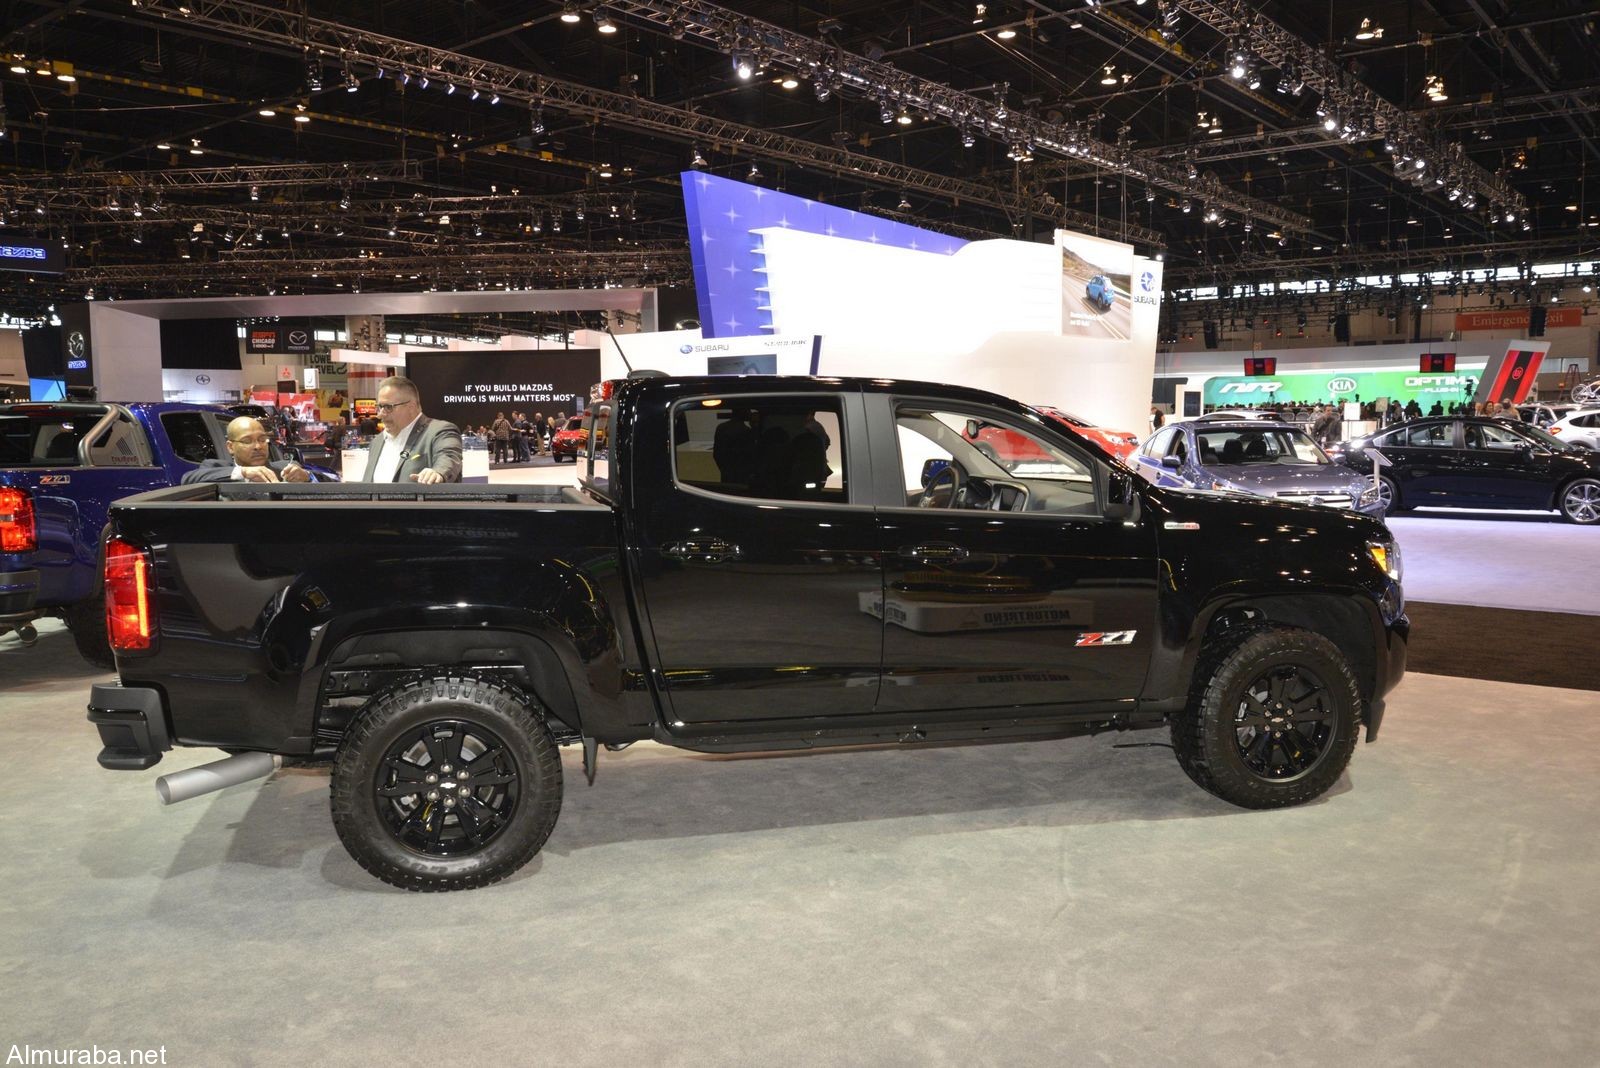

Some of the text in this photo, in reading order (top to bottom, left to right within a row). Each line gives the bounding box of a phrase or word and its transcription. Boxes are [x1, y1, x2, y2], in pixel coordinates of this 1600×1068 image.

[1134, 295, 1157, 305] SUBARU
[1472, 316, 1529, 327] Emergenc
[695, 344, 729, 352] SUBARU
[310, 355, 336, 365] LOWE
[1405, 376, 1479, 386] OPTIMA
[494, 384, 517, 392] BUILD
[444, 395, 477, 403] DRIVING
[514, 394, 551, 402] MATTERS
[1075, 630, 1137, 646] Z71
